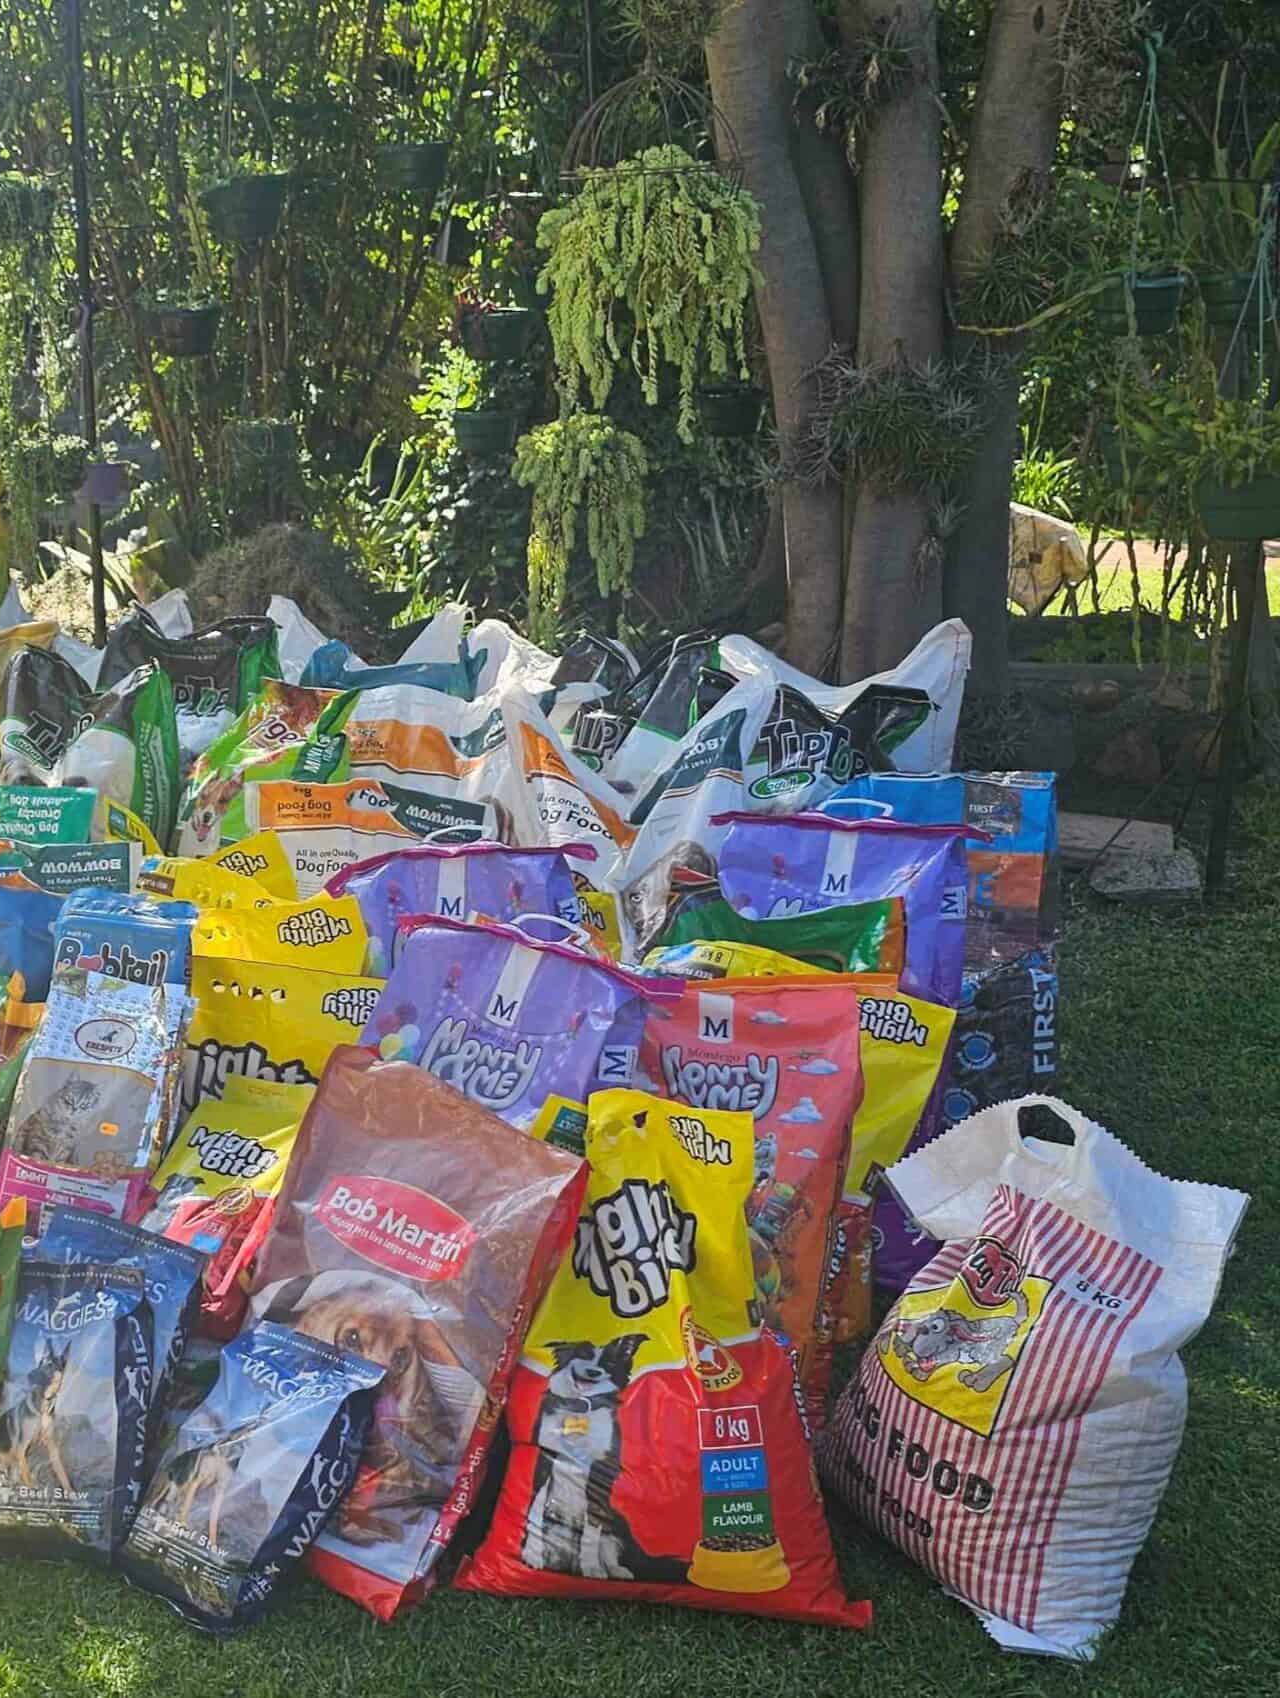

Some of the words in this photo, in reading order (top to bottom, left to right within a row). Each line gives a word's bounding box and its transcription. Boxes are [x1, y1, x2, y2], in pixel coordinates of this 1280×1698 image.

[277, 801, 304, 811] Food
[308, 800, 332, 811] Dog
[296, 850, 308, 858] All
[39, 860, 123, 875] BOWWOW
[296, 859, 325, 876] Dog
[326, 860, 352, 875] Foo
[824, 873, 849, 893] M
[439, 896, 462, 917] M
[941, 891, 962, 916] M
[287, 908, 328, 930] Bite
[277, 922, 352, 948] Mighty
[338, 987, 381, 1004] Bite
[323, 992, 373, 1027] ghty
[489, 995, 518, 1022] M
[861, 998, 911, 1022] Bite
[703, 1017, 729, 1039] M
[859, 1010, 928, 1048] Migh
[1031, 968, 1058, 1074] FIRST
[603, 1049, 626, 1077] M
[200, 1150, 264, 1179] Bite
[328, 1186, 378, 1222] Bob
[377, 1207, 467, 1263] Martin
[1076, 1280, 1089, 1293] 8
[1091, 1291, 1123, 1310] KG
[715, 1415, 725, 1439] 8
[729, 1416, 751, 1442] kg
[710, 1457, 759, 1473] ADULT
[888, 1429, 995, 1514] FOOD
[19, 1485, 49, 1499] Beef
[54, 1487, 89, 1500] Stew
[722, 1502, 753, 1514] LAMB
[713, 1514, 764, 1527] FLAVOUR
